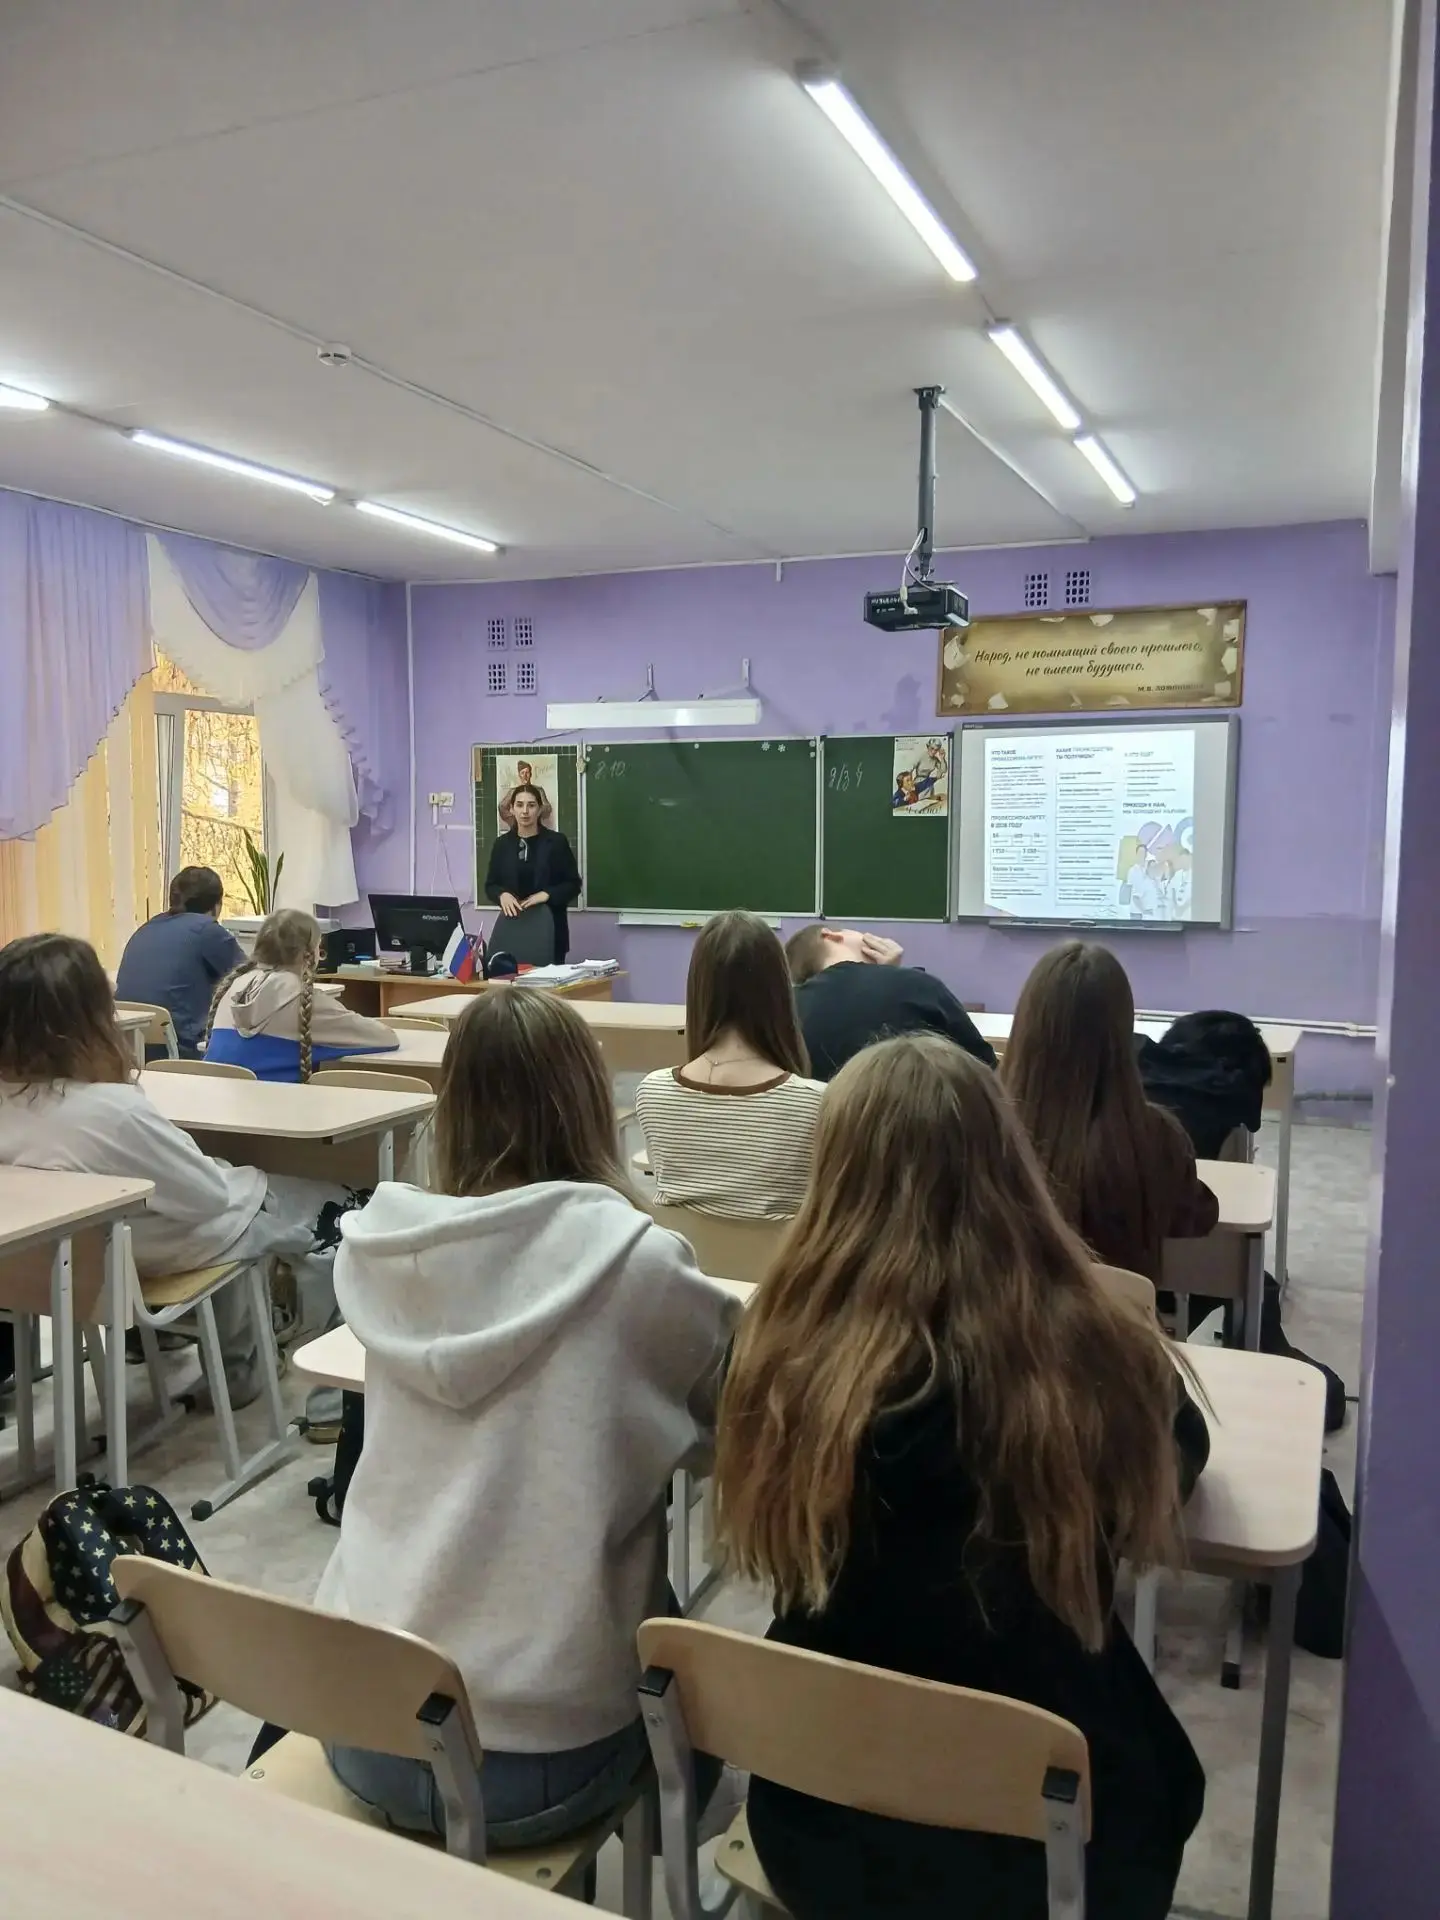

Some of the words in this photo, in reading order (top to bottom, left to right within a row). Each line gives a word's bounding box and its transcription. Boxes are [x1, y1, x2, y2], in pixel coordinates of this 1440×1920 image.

[975, 650, 1011, 666] Народ,
[1015, 650, 1029, 660] не
[1032, 644, 1097, 659] помнящий
[1101, 641, 1138, 656] своего
[1140, 642, 1203, 657] прошлого,
[1026, 666, 1040, 677] не
[1043, 664, 1084, 675] имеет
[1087, 659, 1145, 678] будущего.
